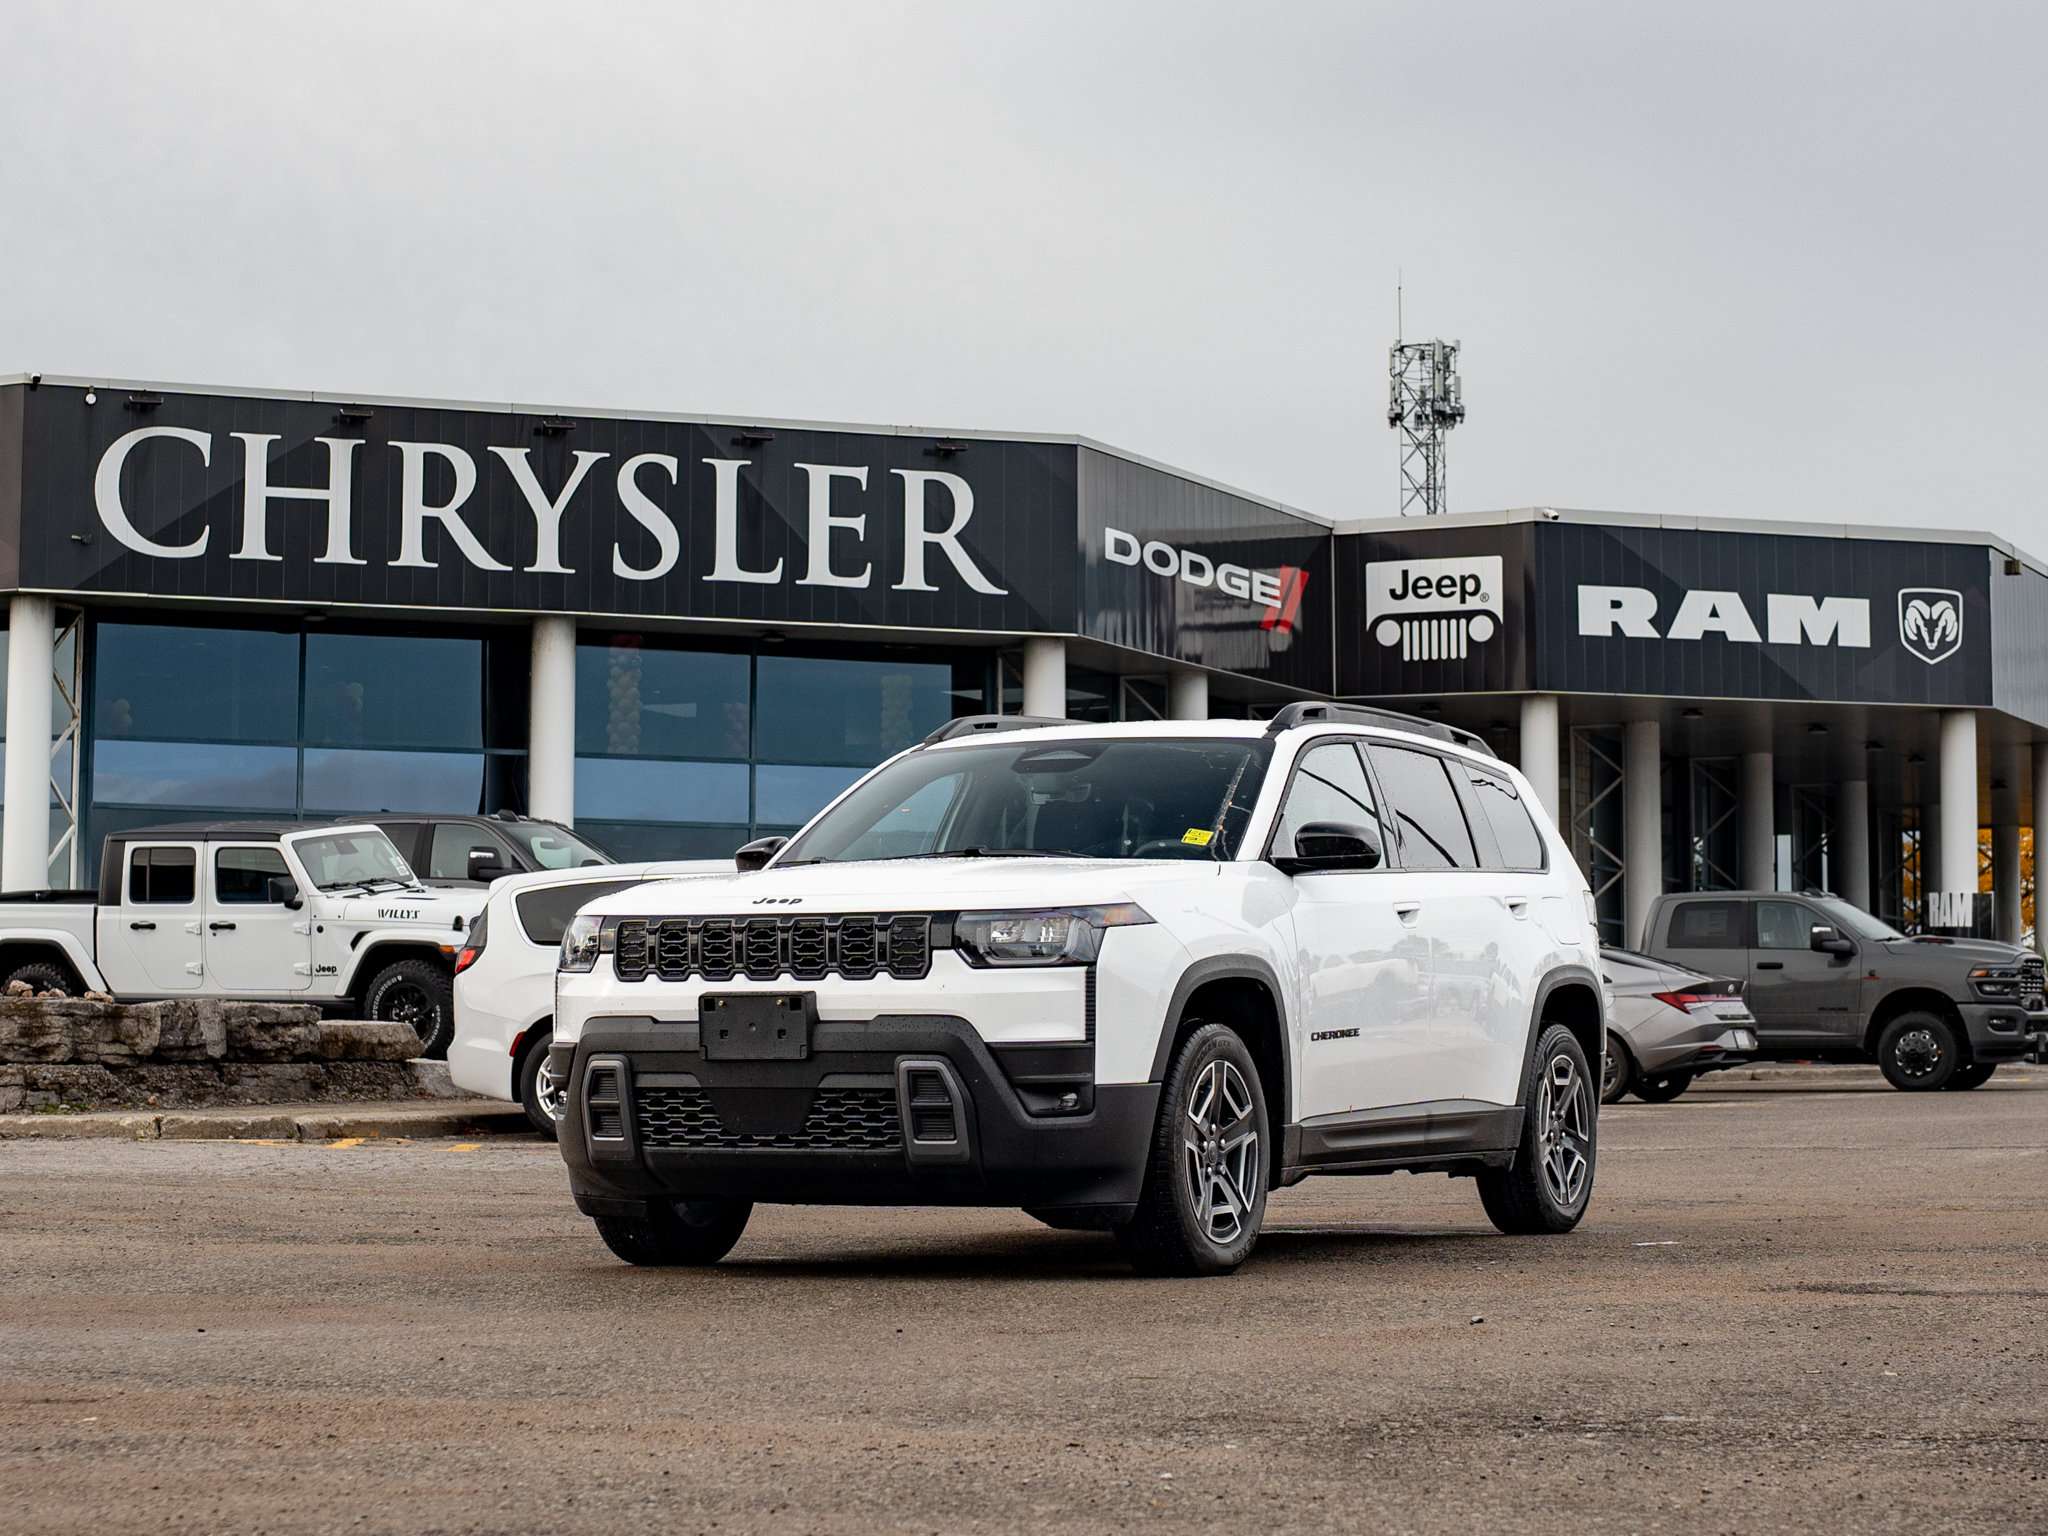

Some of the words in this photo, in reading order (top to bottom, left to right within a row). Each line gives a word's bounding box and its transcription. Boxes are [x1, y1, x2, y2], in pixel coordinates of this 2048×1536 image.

[94, 426, 1009, 595] CHRYSLER
[1105, 527, 1282, 609] DODGE
[1577, 584, 1871, 648] RAM
[377, 908, 420, 919] WILLYS
[752, 897, 803, 906] Jeep
[1928, 892, 1973, 928] RAM
[315, 963, 337, 974] Jeep
[1310, 1027, 1360, 1042] CHEROKEE
